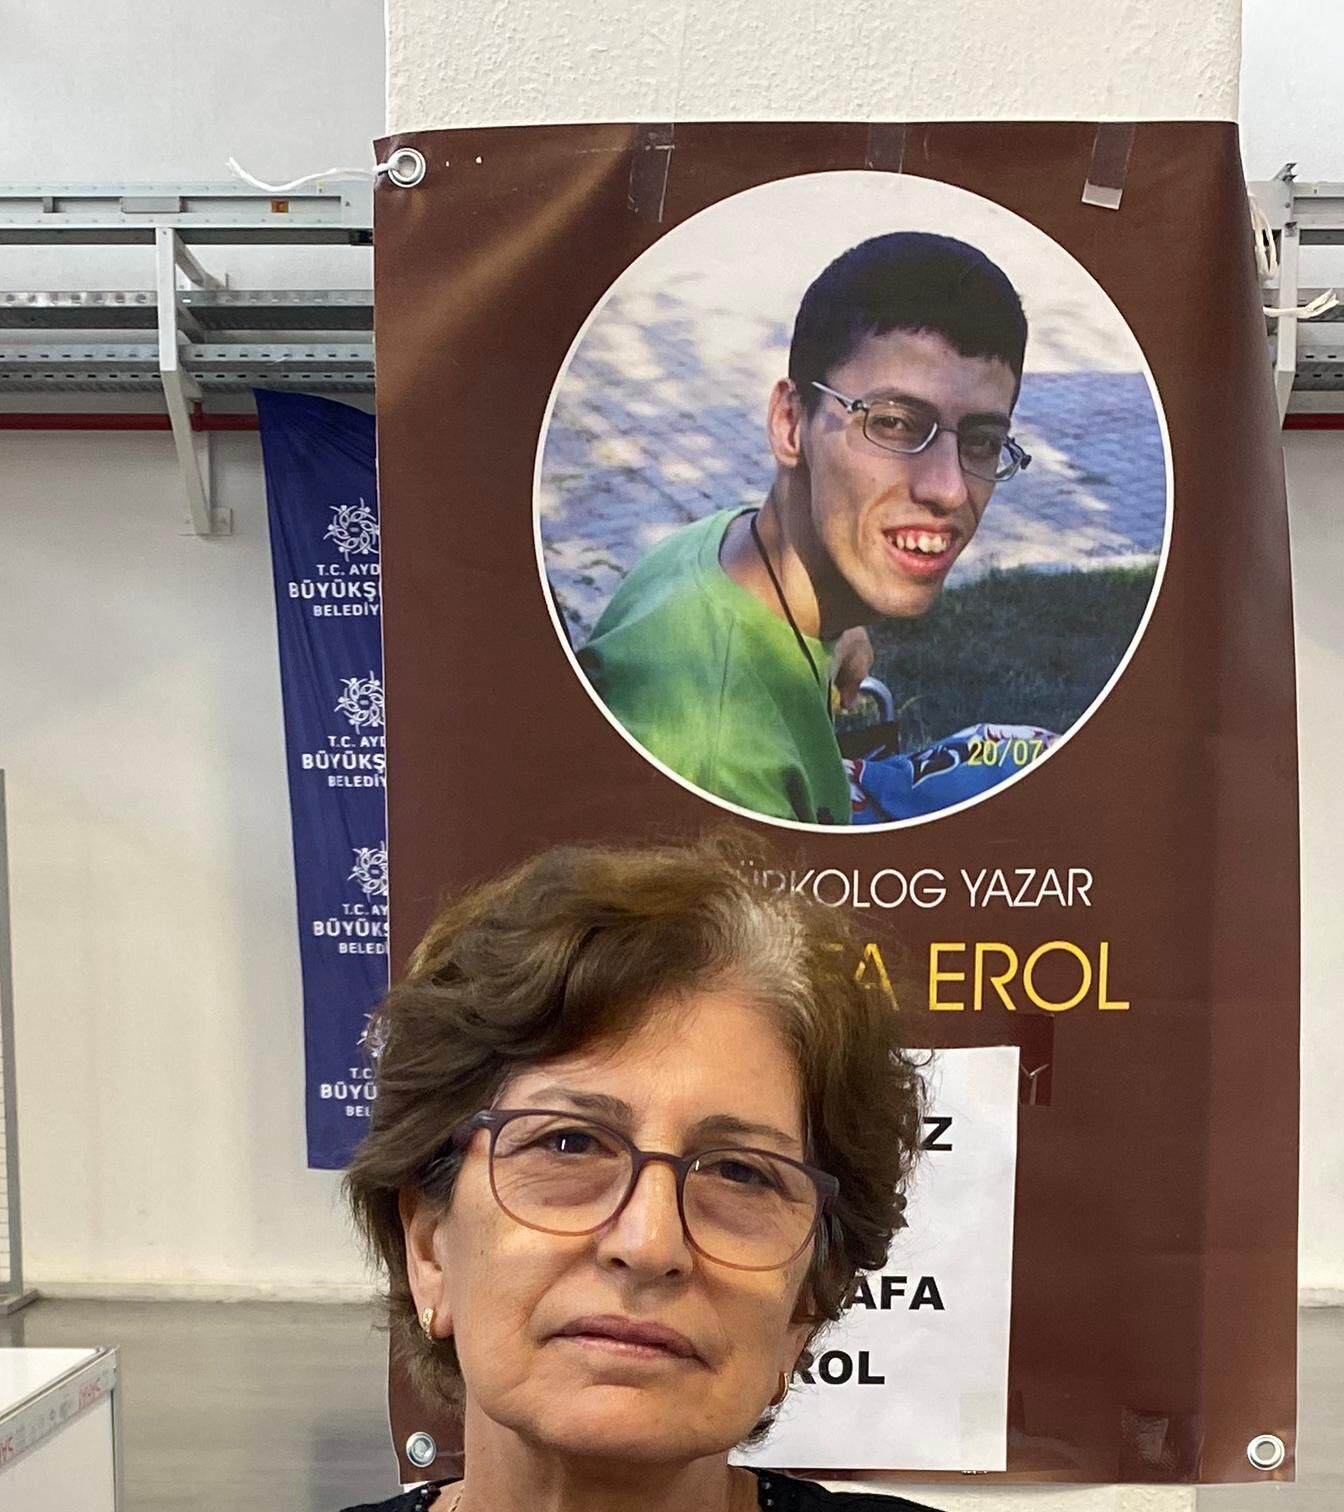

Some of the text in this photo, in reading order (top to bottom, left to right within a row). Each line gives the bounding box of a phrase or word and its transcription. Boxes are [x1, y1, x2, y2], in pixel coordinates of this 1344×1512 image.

[289, 579, 376, 602] BÜYÜKŞ
[961, 868, 1093, 907] YAZAR
[929, 941, 1130, 1011] EROL
